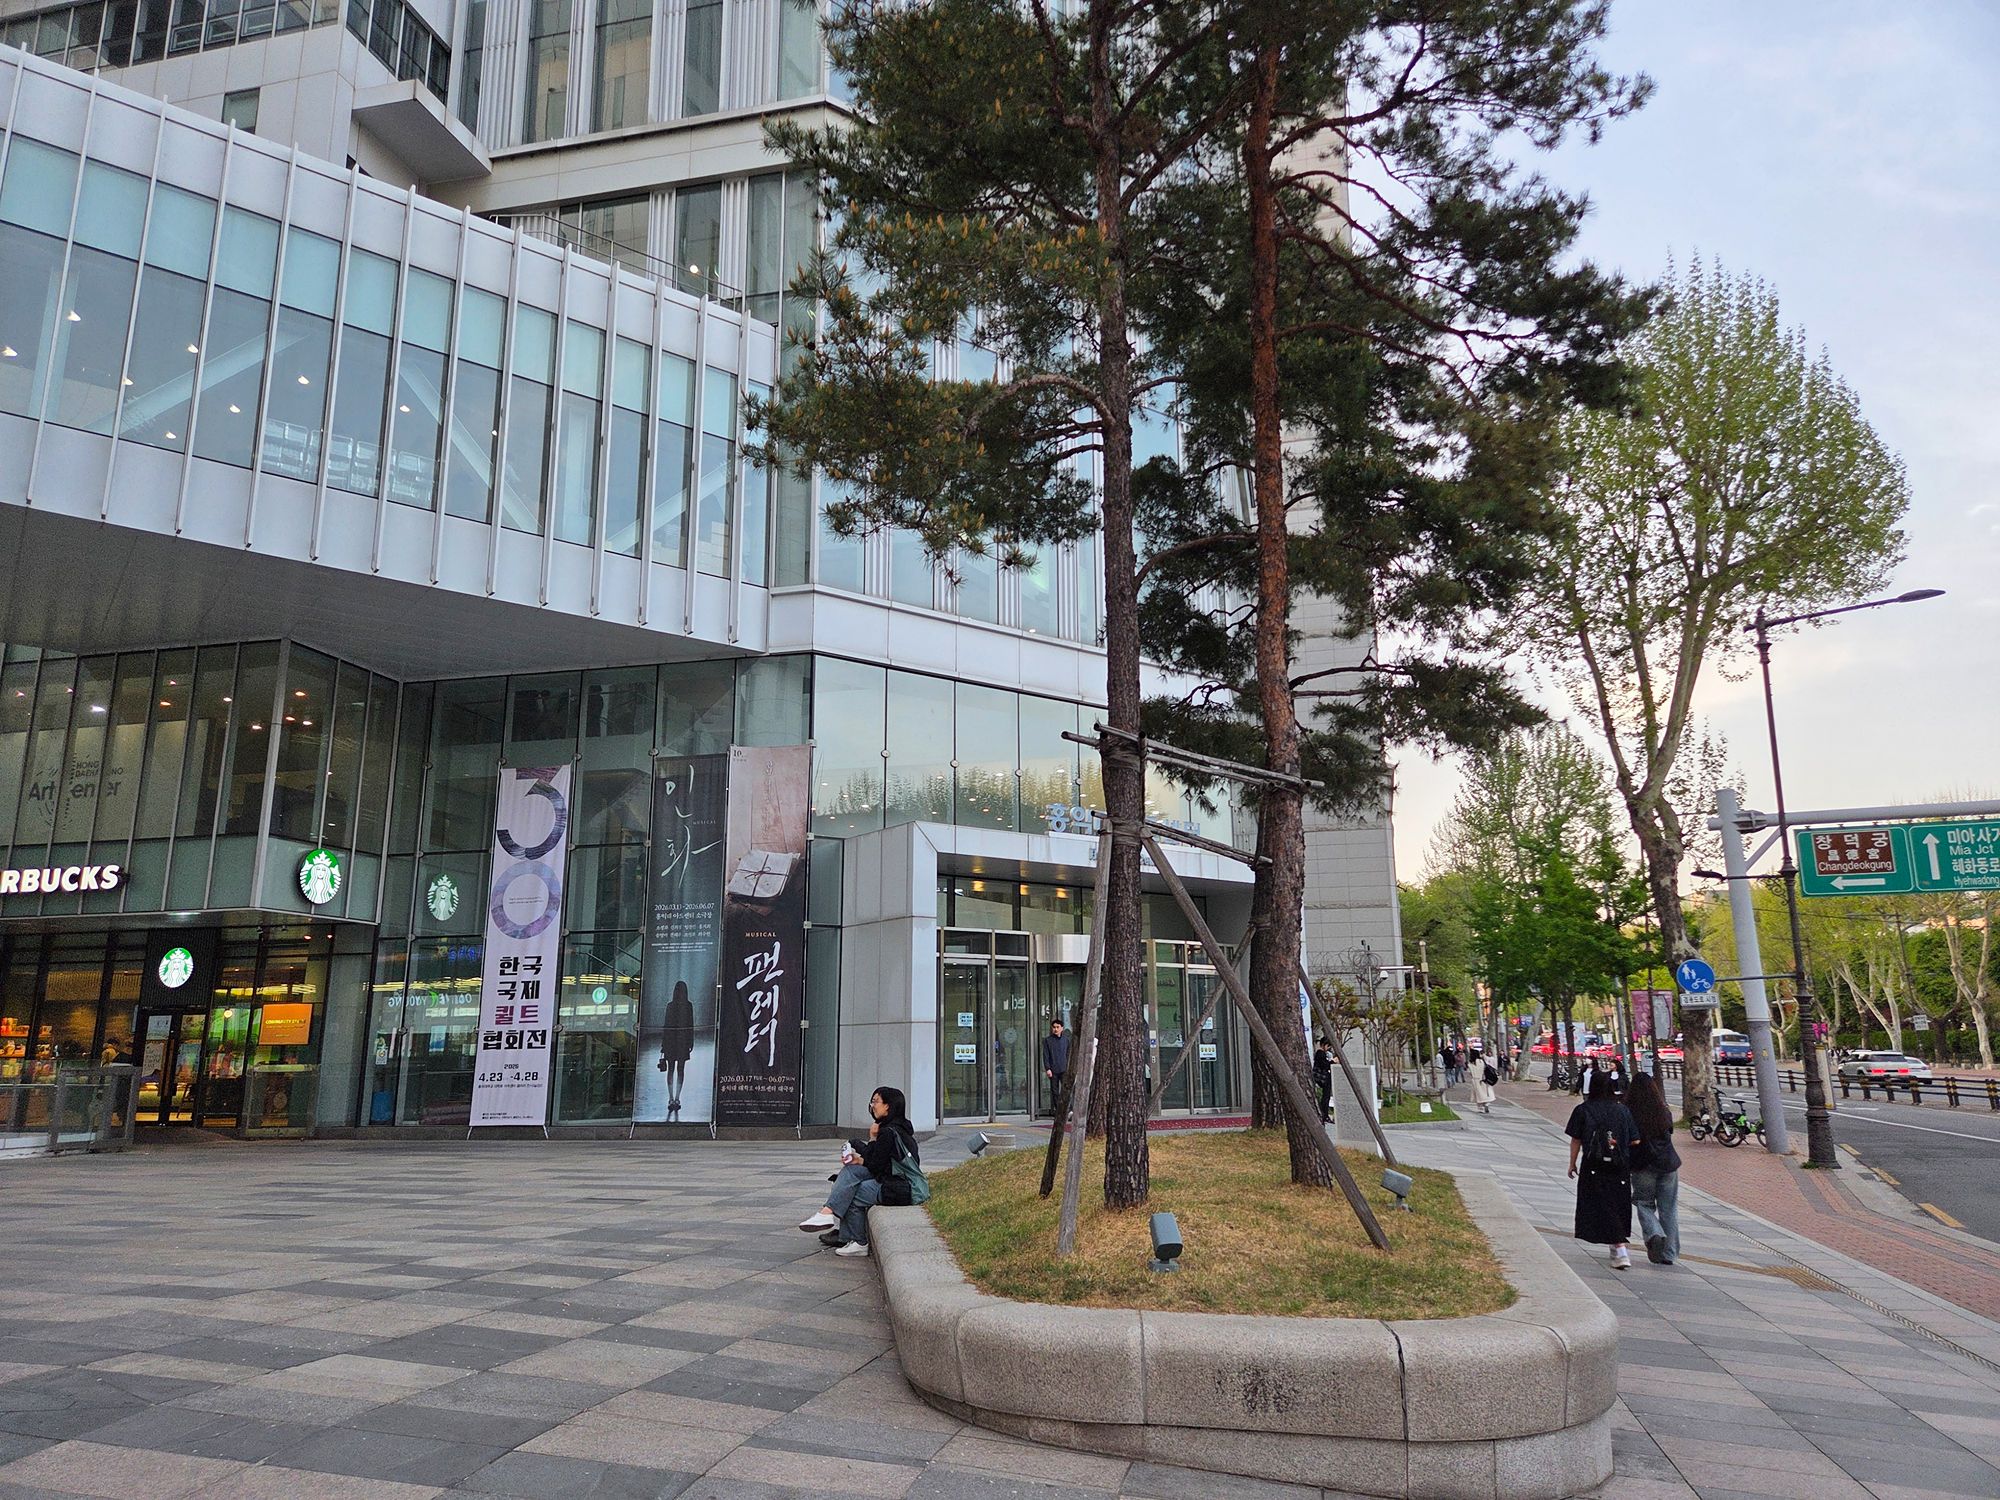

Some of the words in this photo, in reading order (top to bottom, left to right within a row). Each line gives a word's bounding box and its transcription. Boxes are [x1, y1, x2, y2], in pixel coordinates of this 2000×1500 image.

[29, 780, 56, 801] Art
[1046, 802, 1101, 836] 홍익
[1949, 845, 1972, 856] Mia
[1975, 843, 1995, 855] Jct
[1818, 860, 1893, 873] Changdeokgung
[499, 956, 542, 976] 한국
[497, 980, 541, 1000] 국제
[736, 941, 784, 1067] 팬레터
[495, 1005, 538, 1025] 퀼트
[483, 1030, 547, 1050] 협회전
[479, 1072, 503, 1082] 4.23
[720, 1075, 752, 1083] 2026.03.17
